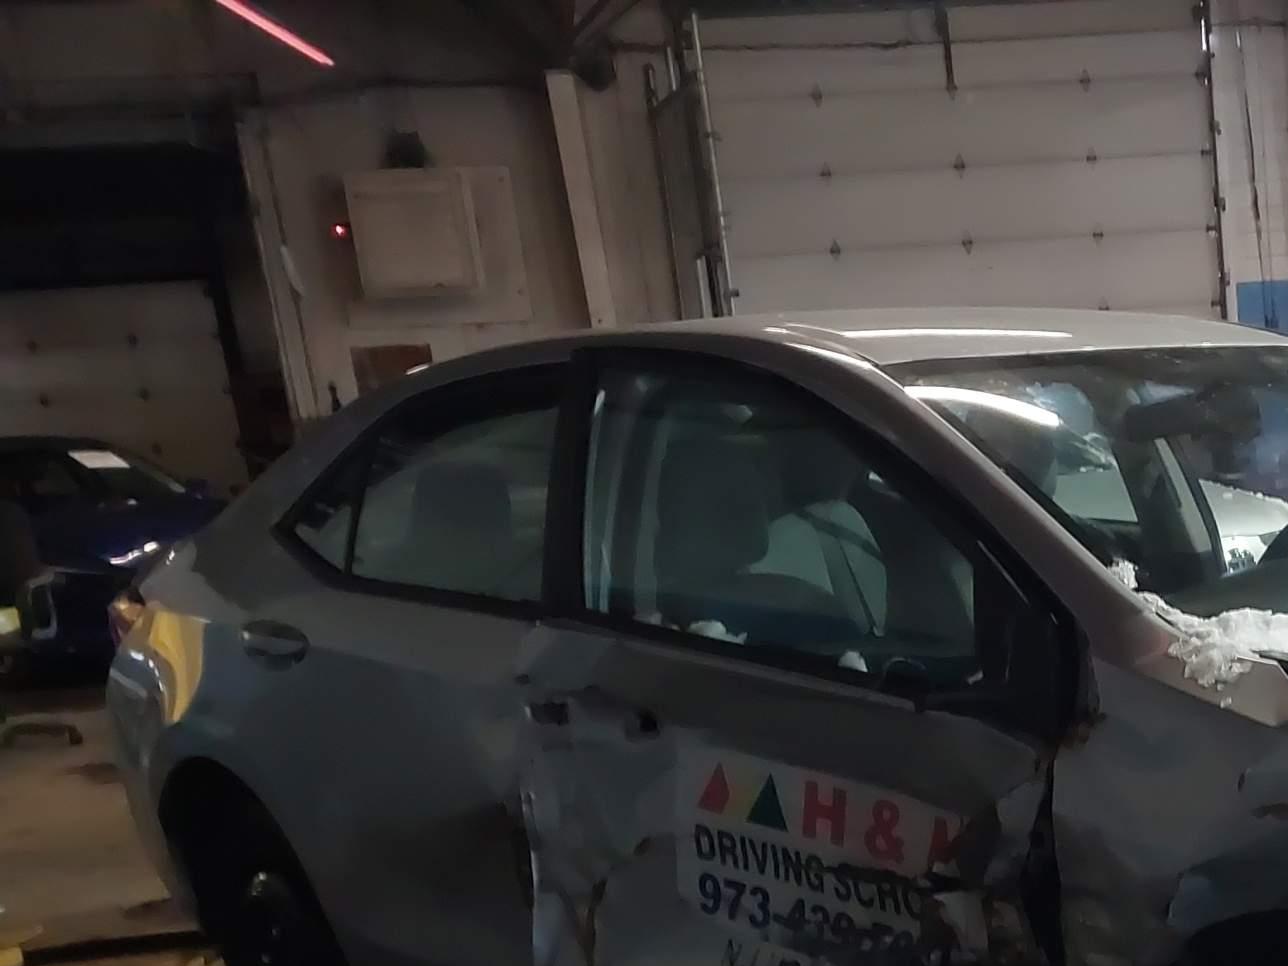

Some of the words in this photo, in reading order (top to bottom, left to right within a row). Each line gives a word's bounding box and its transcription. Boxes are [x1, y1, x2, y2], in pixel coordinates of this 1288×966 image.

[693, 823, 825, 895] DRIVING
[802, 780, 848, 848] H
[864, 800, 905, 865] &
